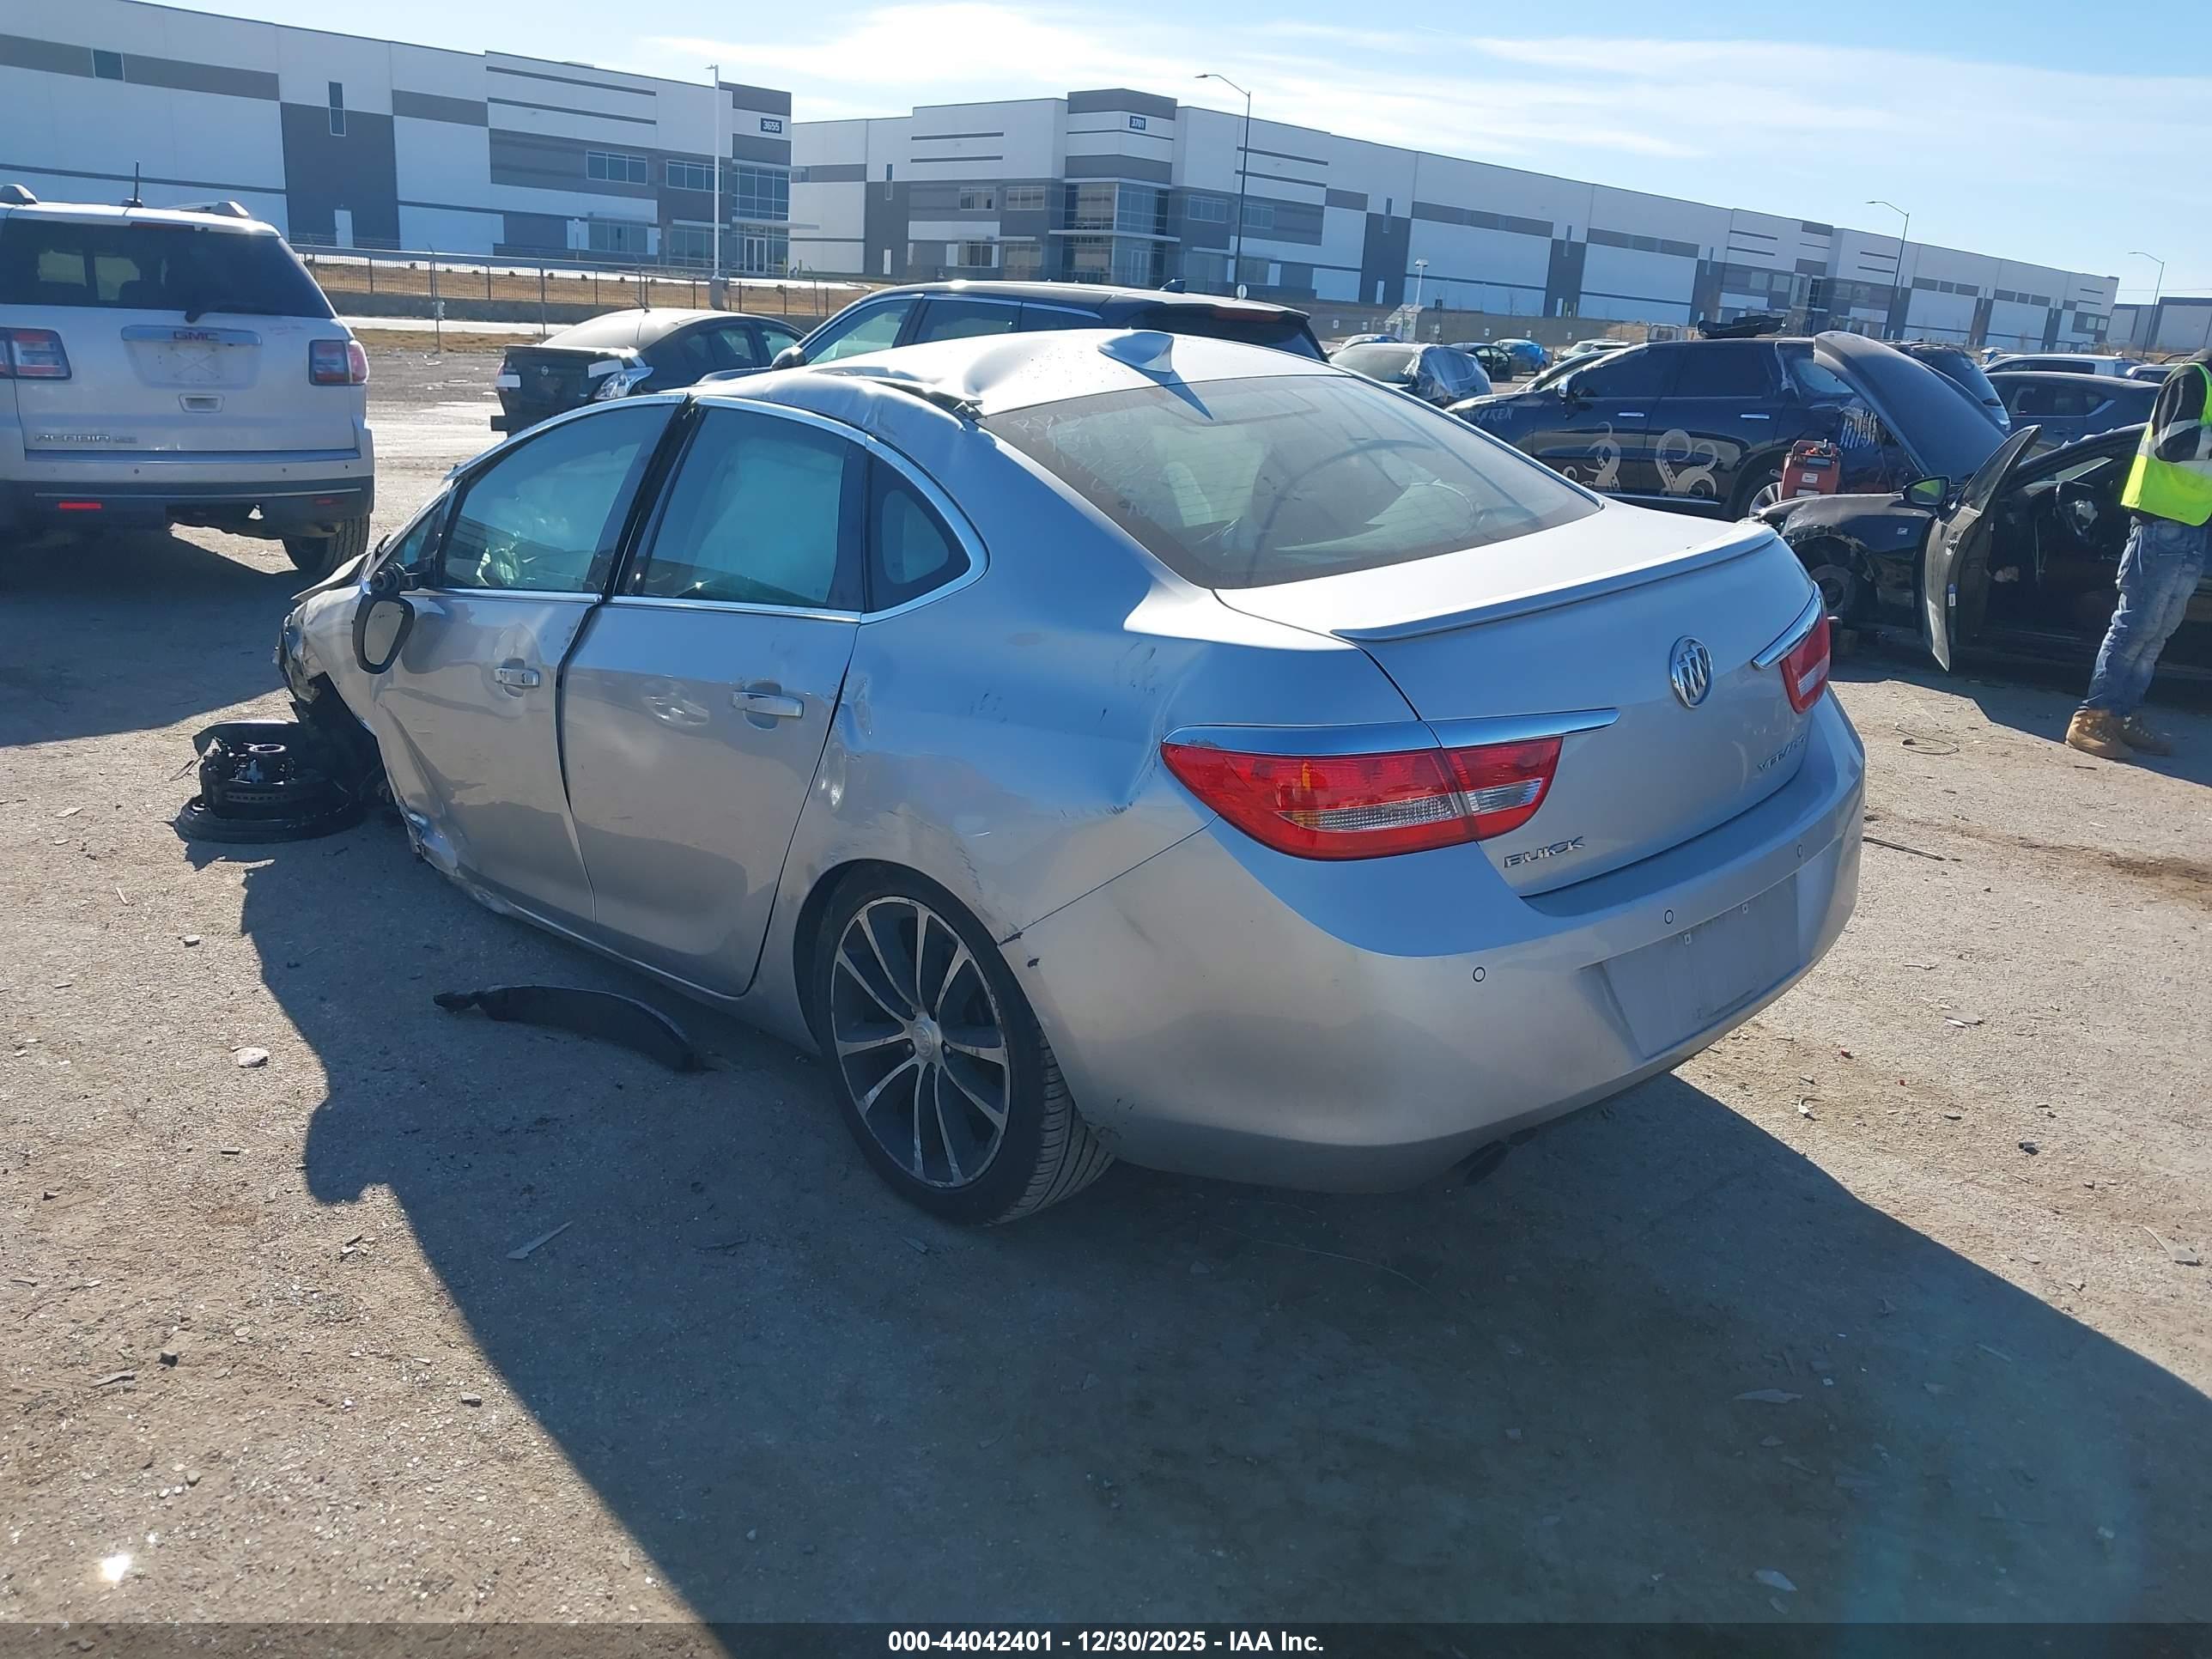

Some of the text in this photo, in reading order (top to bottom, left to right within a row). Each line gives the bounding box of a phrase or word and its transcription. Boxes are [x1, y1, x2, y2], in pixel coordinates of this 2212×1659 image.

[763, 119, 781, 131] 3655
[173, 331, 218, 341] GMC
[1504, 836, 1584, 868] BUICK
